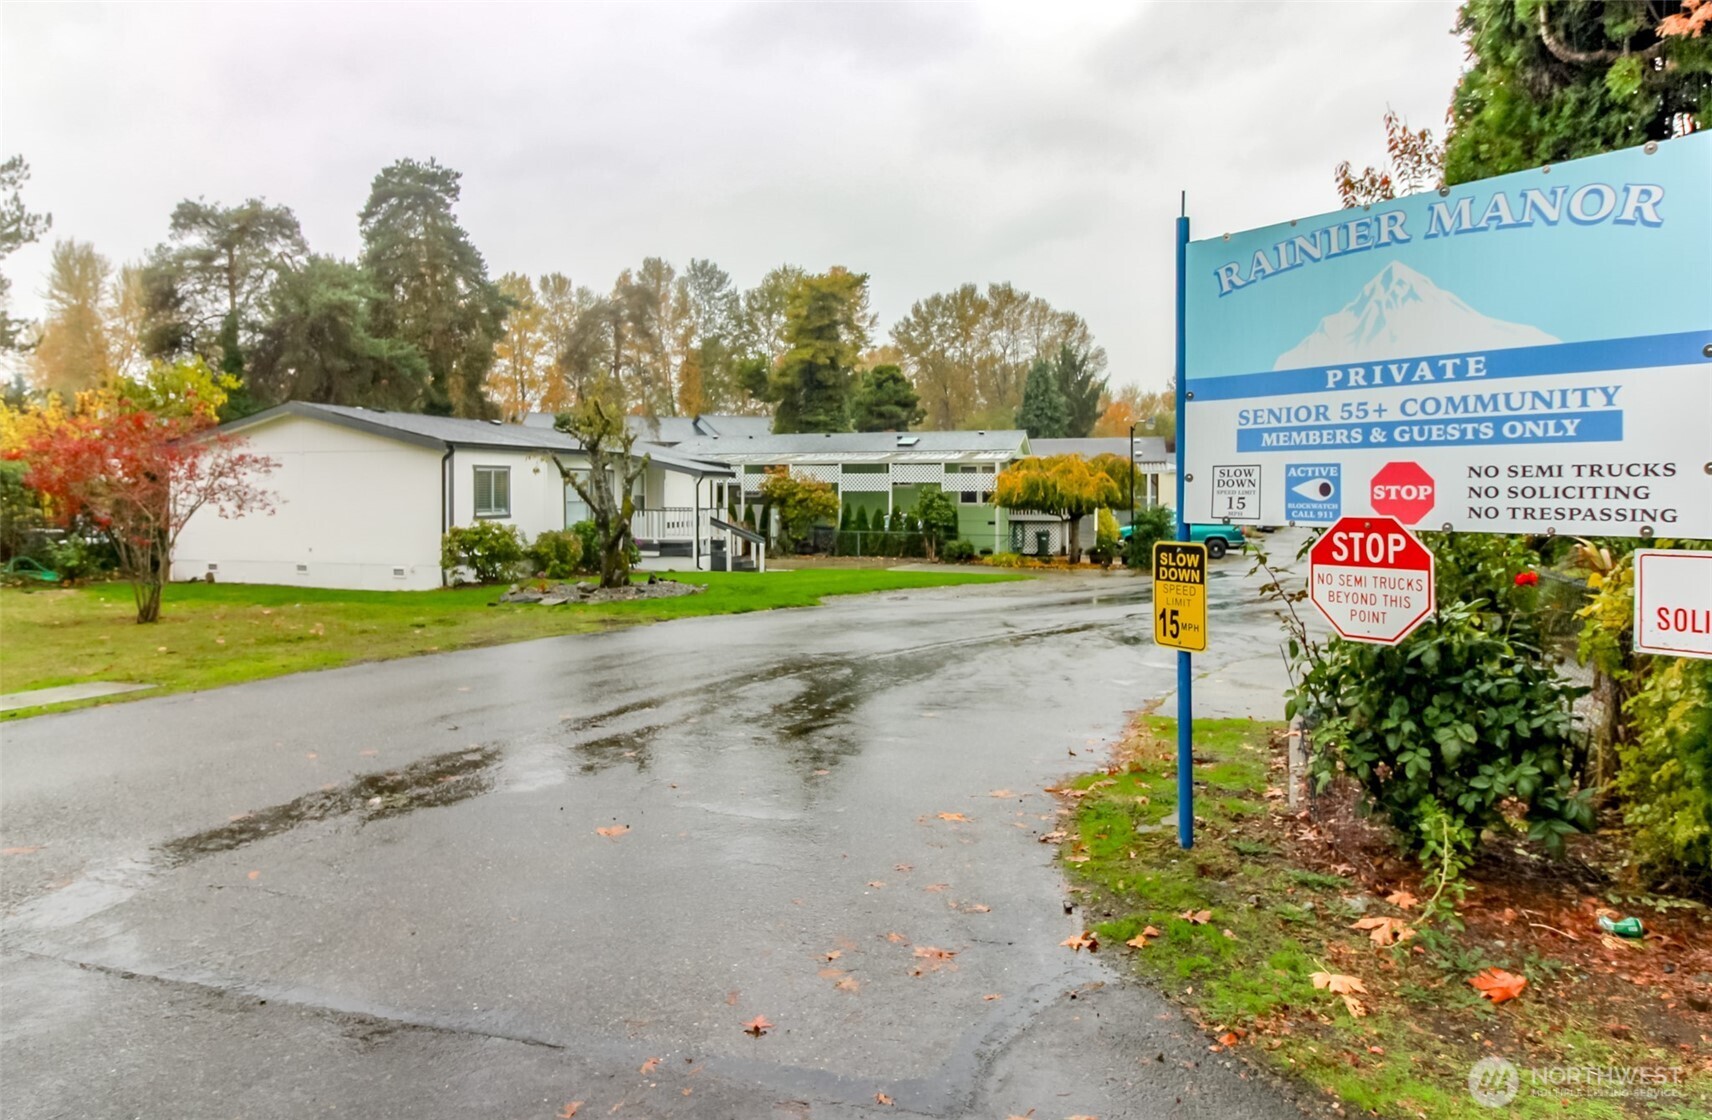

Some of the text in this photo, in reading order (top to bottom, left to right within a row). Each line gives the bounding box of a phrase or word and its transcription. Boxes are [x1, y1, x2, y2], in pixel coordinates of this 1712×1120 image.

[1214, 183, 1665, 297] RAINIER MANOR
[1325, 356, 1487, 388] PRIVATE
[1238, 385, 1623, 427] SENIOR 55+ COMMUNITY
[1261, 418, 1581, 447] MEMBERS & GUESTS ONLY
[1219, 468, 1254, 478] SLOW
[1288, 467, 1338, 477] ACTIVE
[1467, 462, 1677, 478] NO SEMI TRUCKS
[1217, 478, 1256, 488] DOWN
[1373, 485, 1433, 500] STOP
[1467, 485, 1650, 500] NO SOLICITING
[1227, 496, 1246, 510] 15
[1291, 510, 1333, 518] CALL 911
[1467, 506, 1678, 523] NO TRESPASSING
[1332, 531, 1406, 564] STOP
[1160, 552, 1199, 567] SLOW
[1160, 567, 1200, 583] DOWN
[1317, 573, 1423, 592] NO SEMI TRUCKS
[1163, 584, 1196, 597] SPEED
[1166, 597, 1192, 607] LIMIT
[1328, 590, 1411, 609] BEYOND THIS
[1159, 608, 1199, 639] 15 MPH
[1350, 609, 1387, 624] POINT
